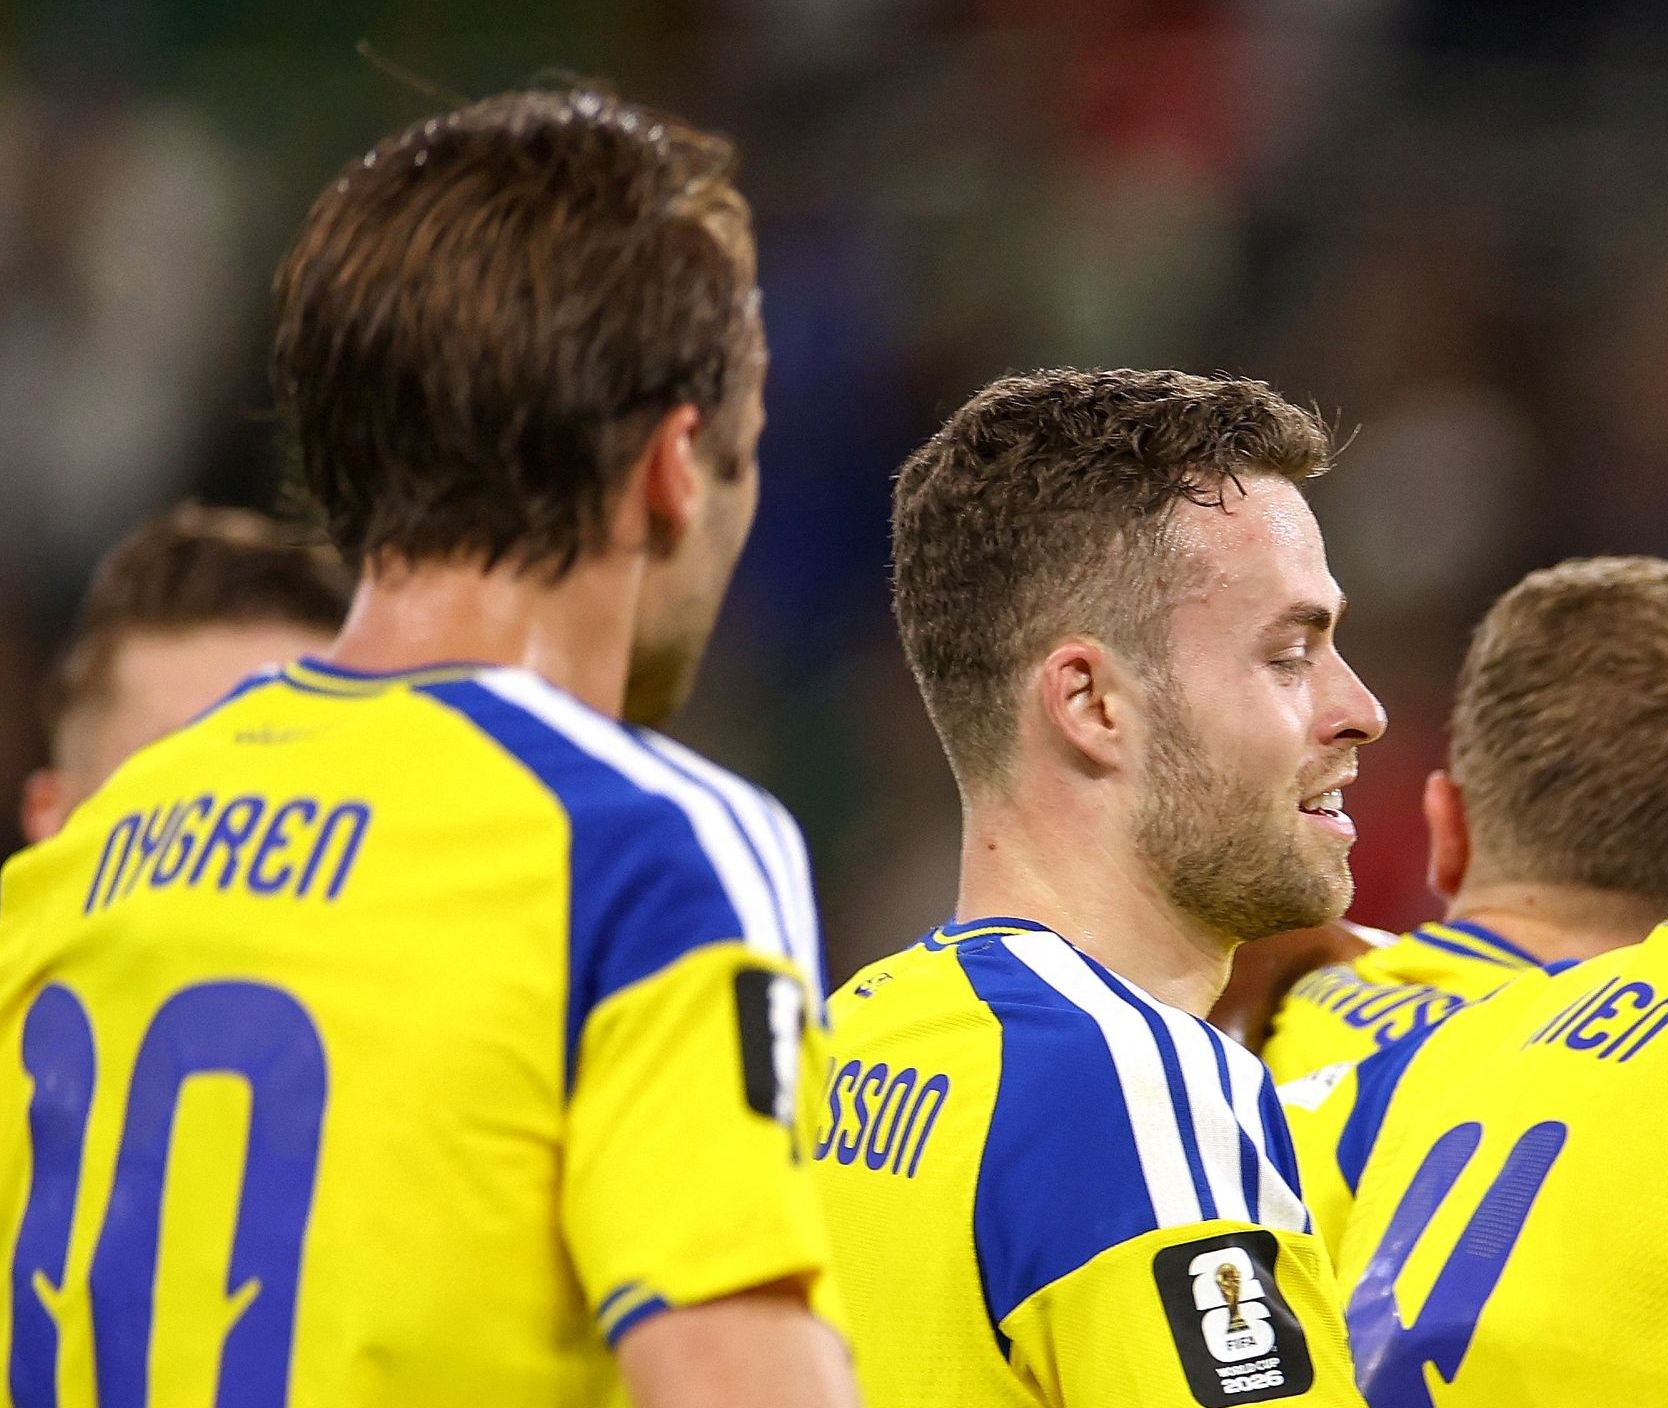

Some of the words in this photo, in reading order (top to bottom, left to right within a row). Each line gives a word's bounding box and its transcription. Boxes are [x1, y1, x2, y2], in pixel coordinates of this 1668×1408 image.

[84, 794, 371, 914] NYGREN
[813, 1057, 949, 1178] SSON
[1220, 1369, 1285, 1394] 2026
